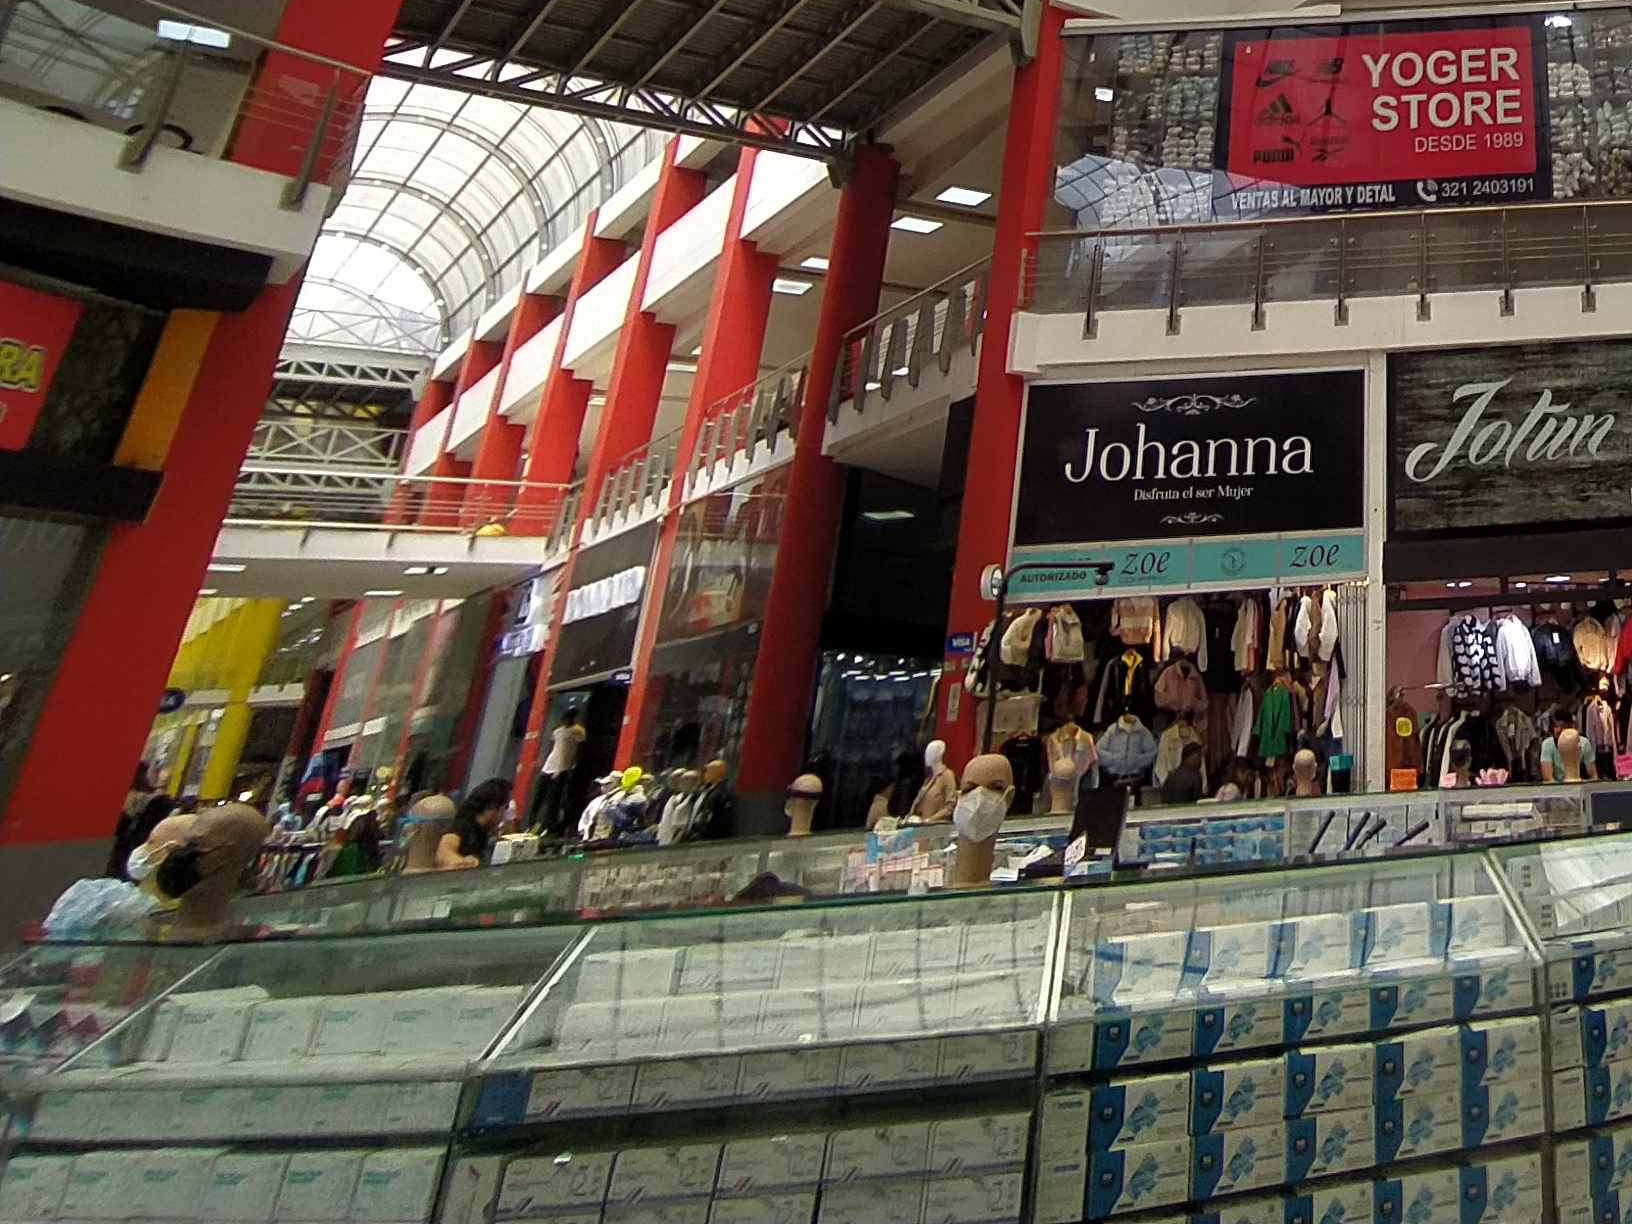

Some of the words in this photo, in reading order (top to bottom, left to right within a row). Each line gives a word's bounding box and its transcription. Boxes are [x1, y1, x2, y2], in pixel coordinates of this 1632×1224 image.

[1361, 47, 1520, 88] YOGER
[1371, 88, 1523, 132] STORE
[1414, 134, 1478, 154] DESDE
[1484, 132, 1524, 150] 1989
[1253, 147, 1294, 164] PUMA
[1230, 188, 1279, 210] VENTAS
[1281, 187, 1297, 207] AL
[1300, 185, 1343, 206] MAYOR
[1346, 186, 1355, 204] Y
[1357, 183, 1396, 204] DETAL
[1441, 180, 1468, 198] 321
[1472, 177, 1535, 196] 2403191
[1064, 422, 1314, 483] Johanna
[1134, 487, 1180, 501] Disfruta
[1182, 486, 1194, 499] el
[1196, 487, 1216, 499] ser
[1217, 485, 1254, 501] Mujer
[1020, 571, 1087, 583] AUTORIZADO
[952, 637, 970, 647] VISA
